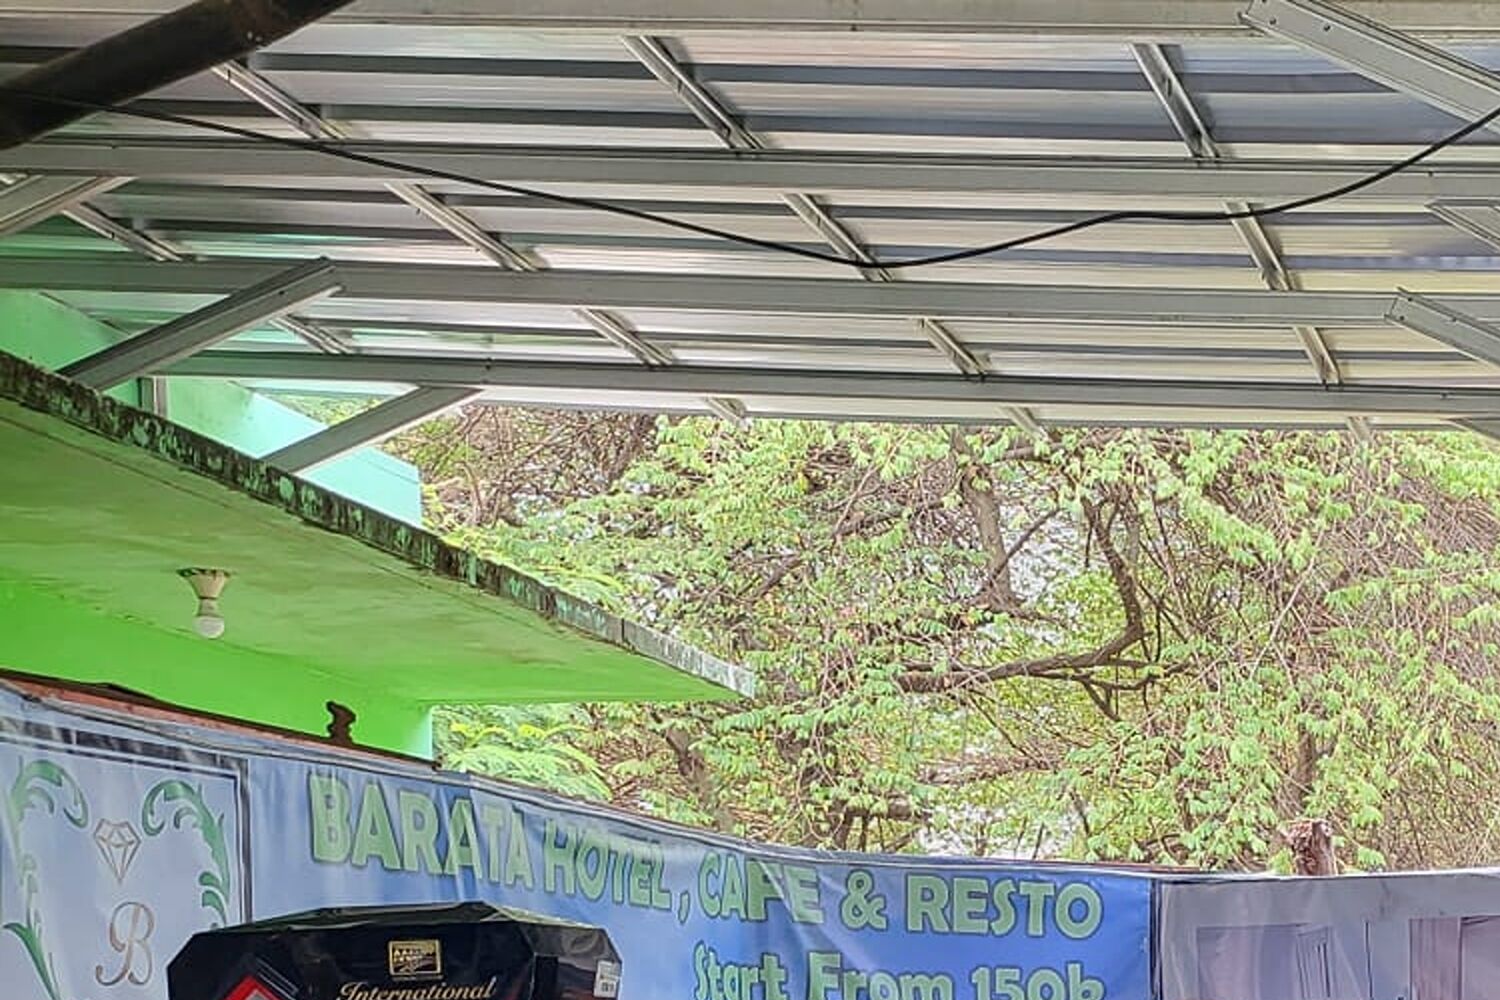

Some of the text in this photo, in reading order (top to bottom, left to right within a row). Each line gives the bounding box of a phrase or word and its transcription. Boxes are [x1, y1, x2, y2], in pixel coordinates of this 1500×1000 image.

[309, 770, 533, 891] BARATA
[698, 853, 823, 924] CAFE
[841, 869, 888, 931] &
[907, 873, 1103, 940] RESTO
